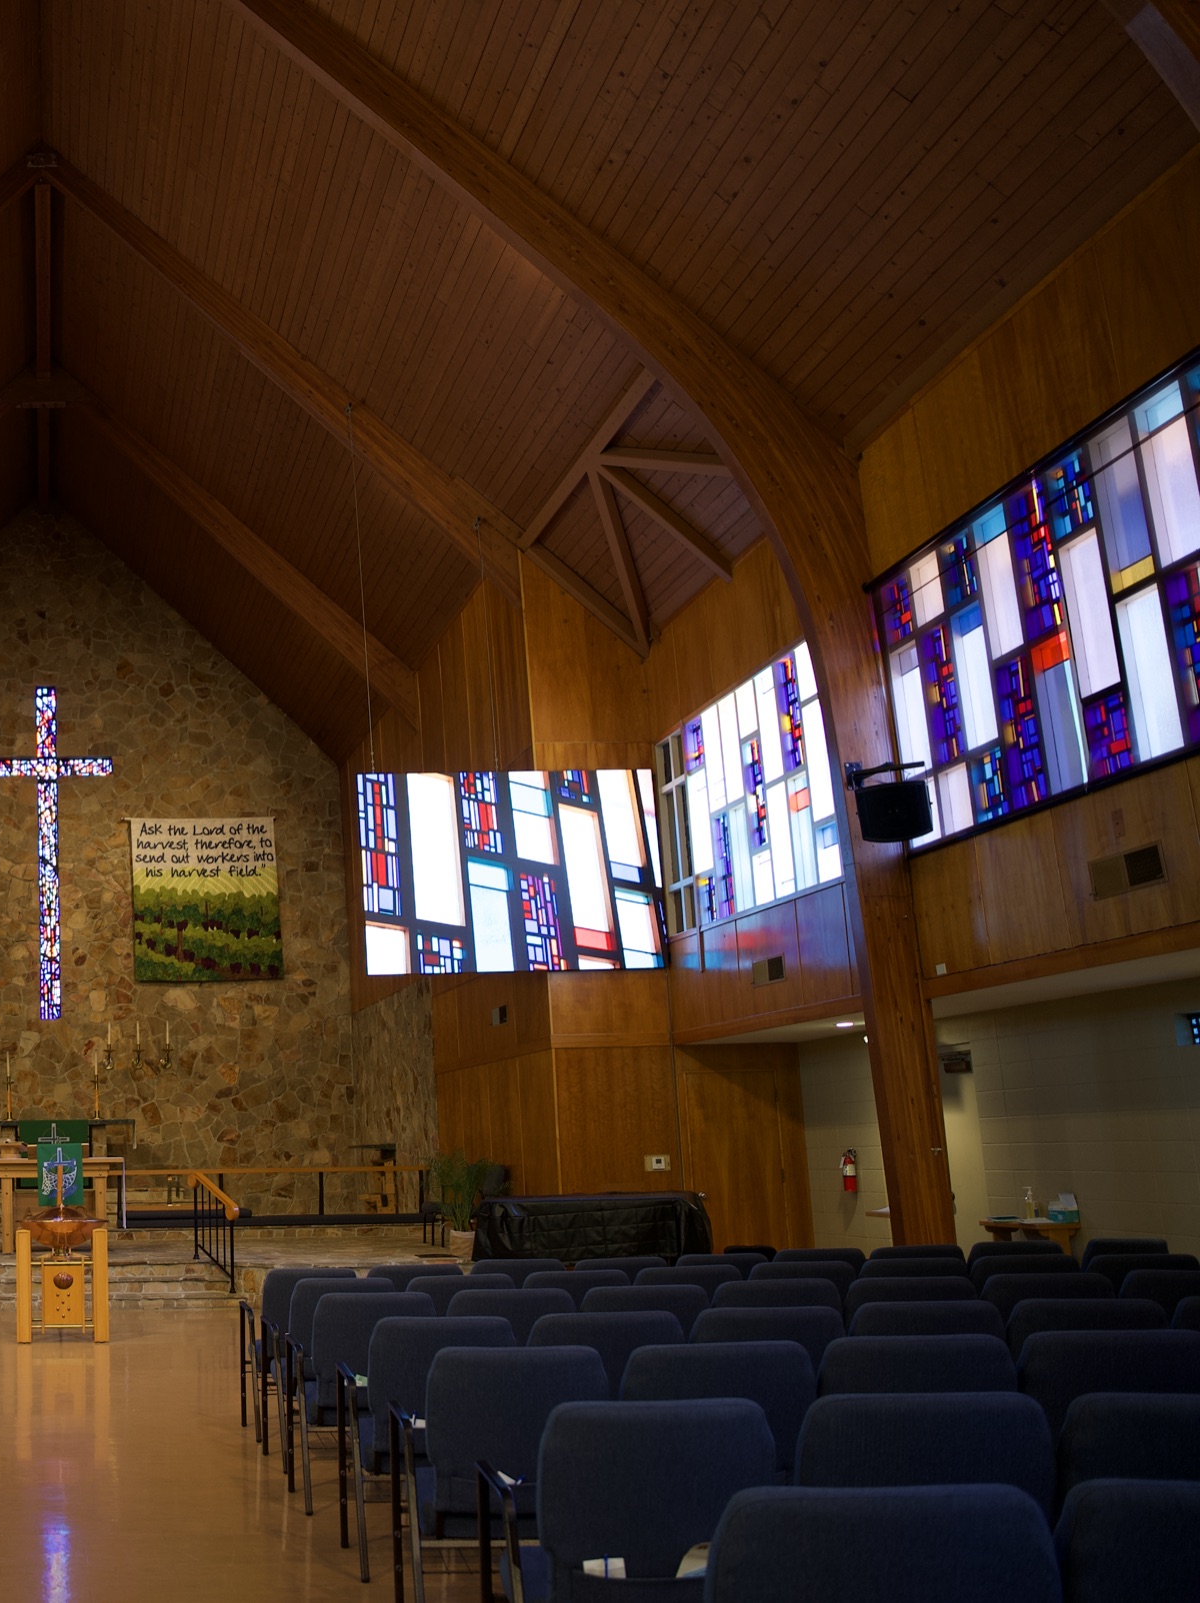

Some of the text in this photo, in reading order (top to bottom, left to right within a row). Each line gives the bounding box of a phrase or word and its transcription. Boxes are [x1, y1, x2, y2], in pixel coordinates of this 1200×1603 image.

[140, 823, 267, 836] Ask the Lord of the
[137, 837, 272, 852] harvest, therefore, to
[135, 851, 274, 864] send out workers into
[146, 865, 265, 878] his harvest field."
